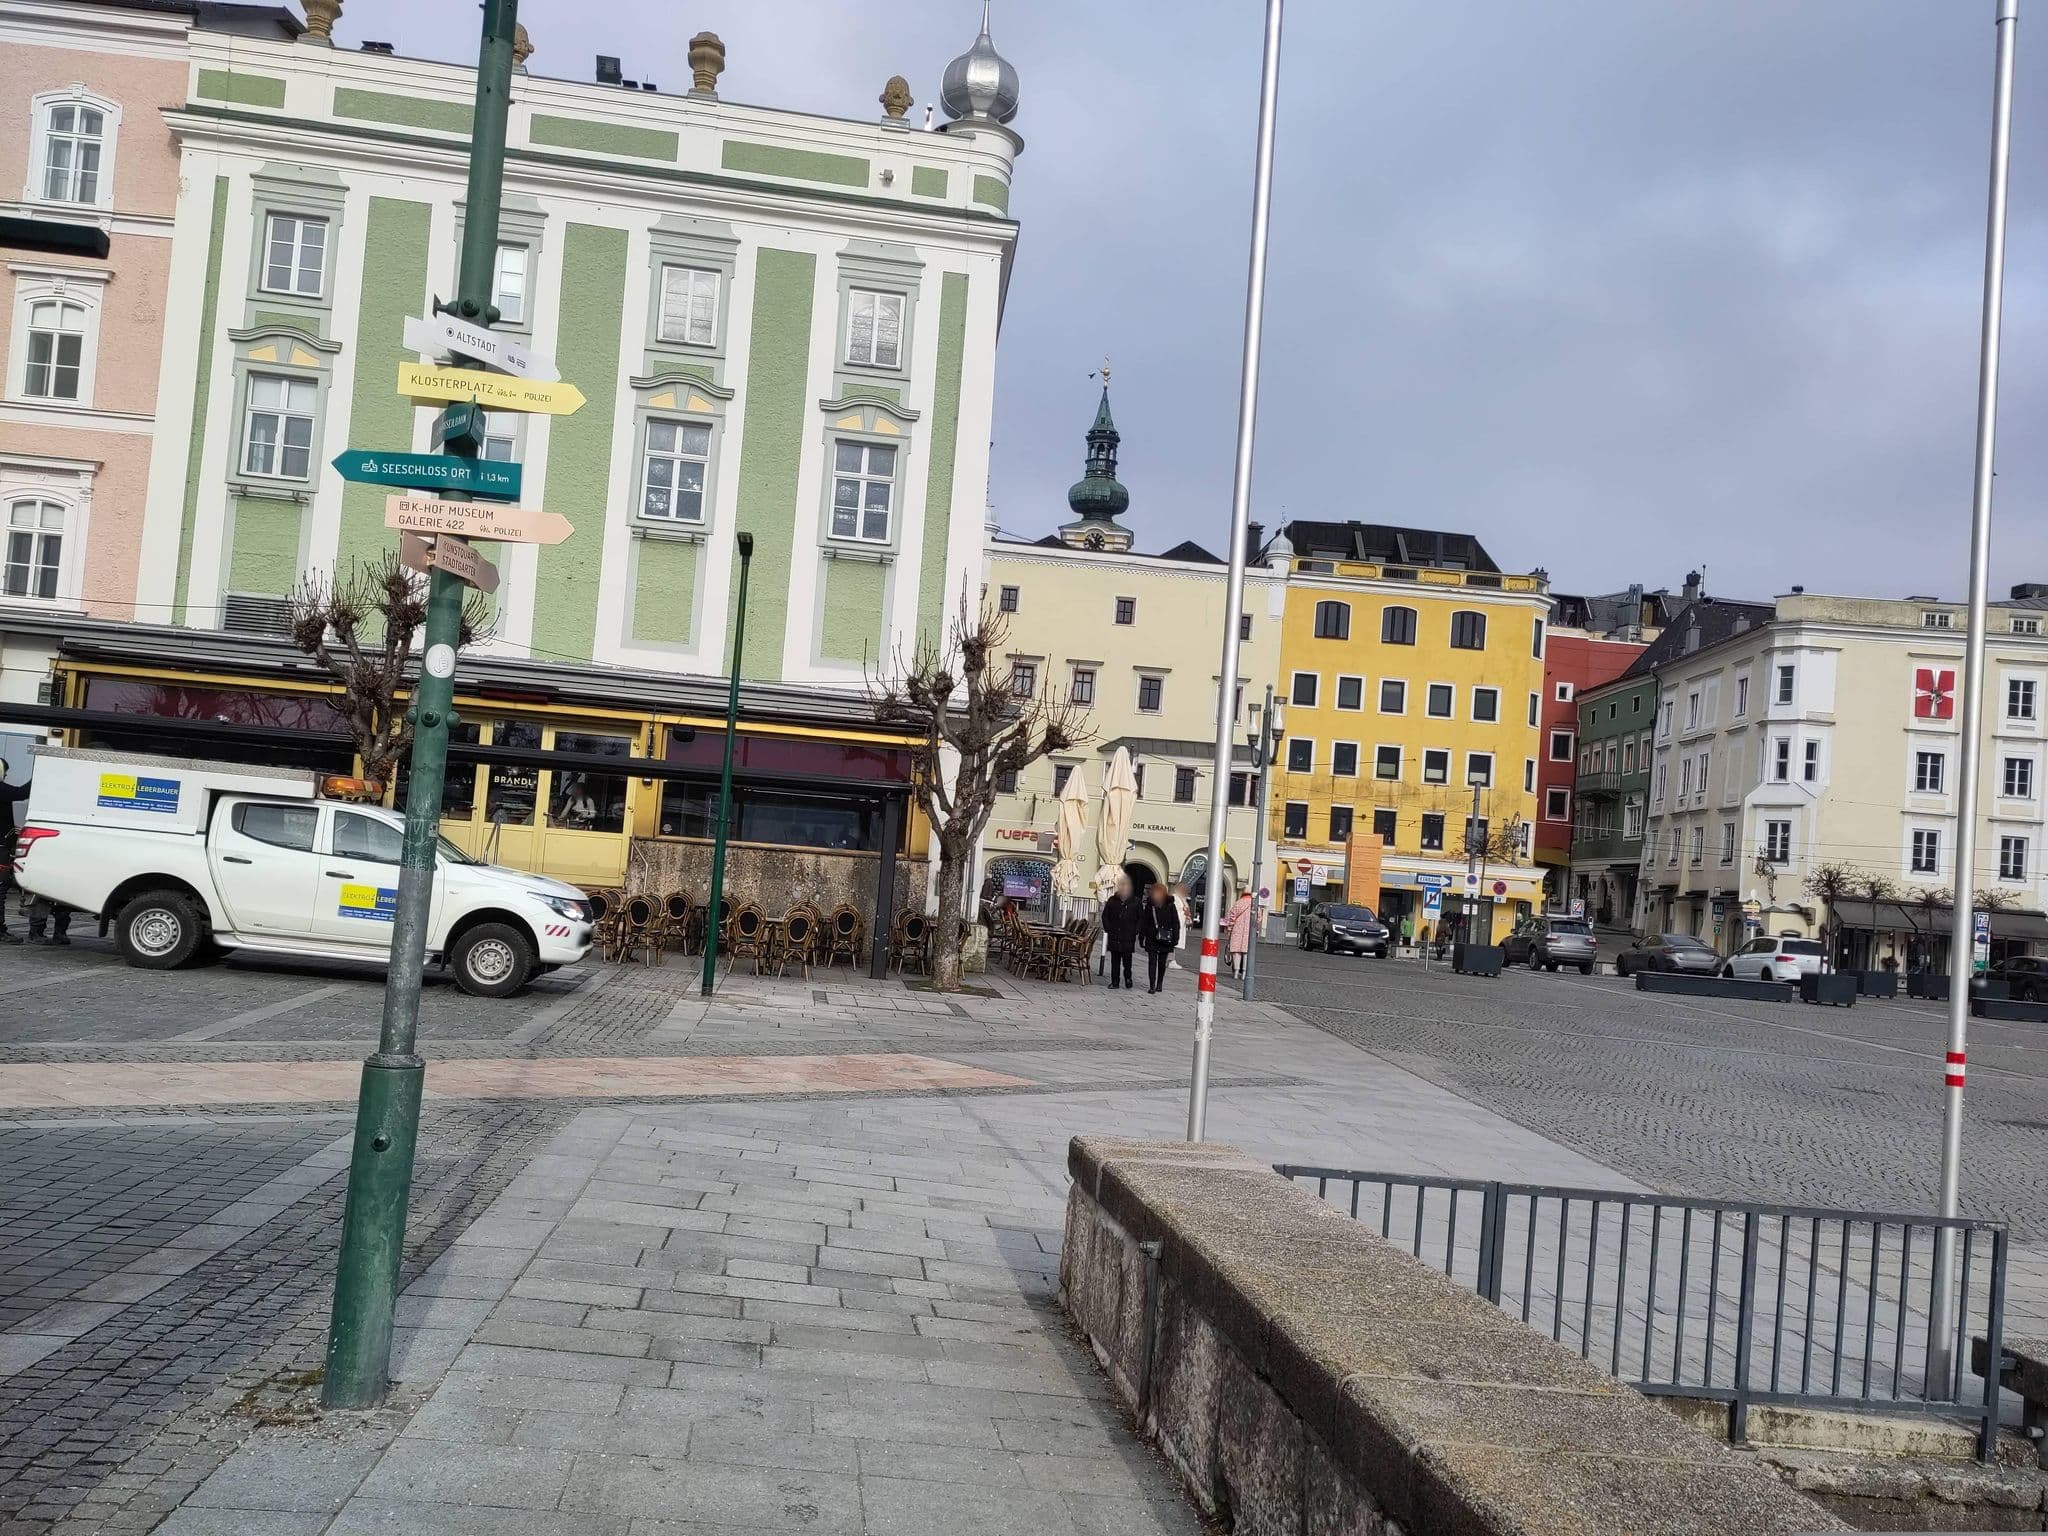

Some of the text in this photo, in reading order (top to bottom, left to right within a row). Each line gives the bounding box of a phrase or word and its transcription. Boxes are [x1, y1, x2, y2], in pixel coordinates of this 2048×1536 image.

[456, 331, 496, 353] ALTSTADT
[410, 374, 552, 402] KLOSTERPLATZ POLIZEI
[381, 463, 448, 477] SEESCHLOSS
[451, 468, 472, 479] ORT
[497, 475, 510, 483] km
[412, 502, 446, 515] K-HOF
[449, 506, 494, 520] MUSEUM
[398, 515, 522, 537] GALERIE 422 POLIZEI
[101, 782, 131, 790] ELEKTRO
[494, 775, 533, 786] BRANDL
[995, 828, 1039, 842] ruefa
[1132, 822, 1176, 833] DER KERAMIK
